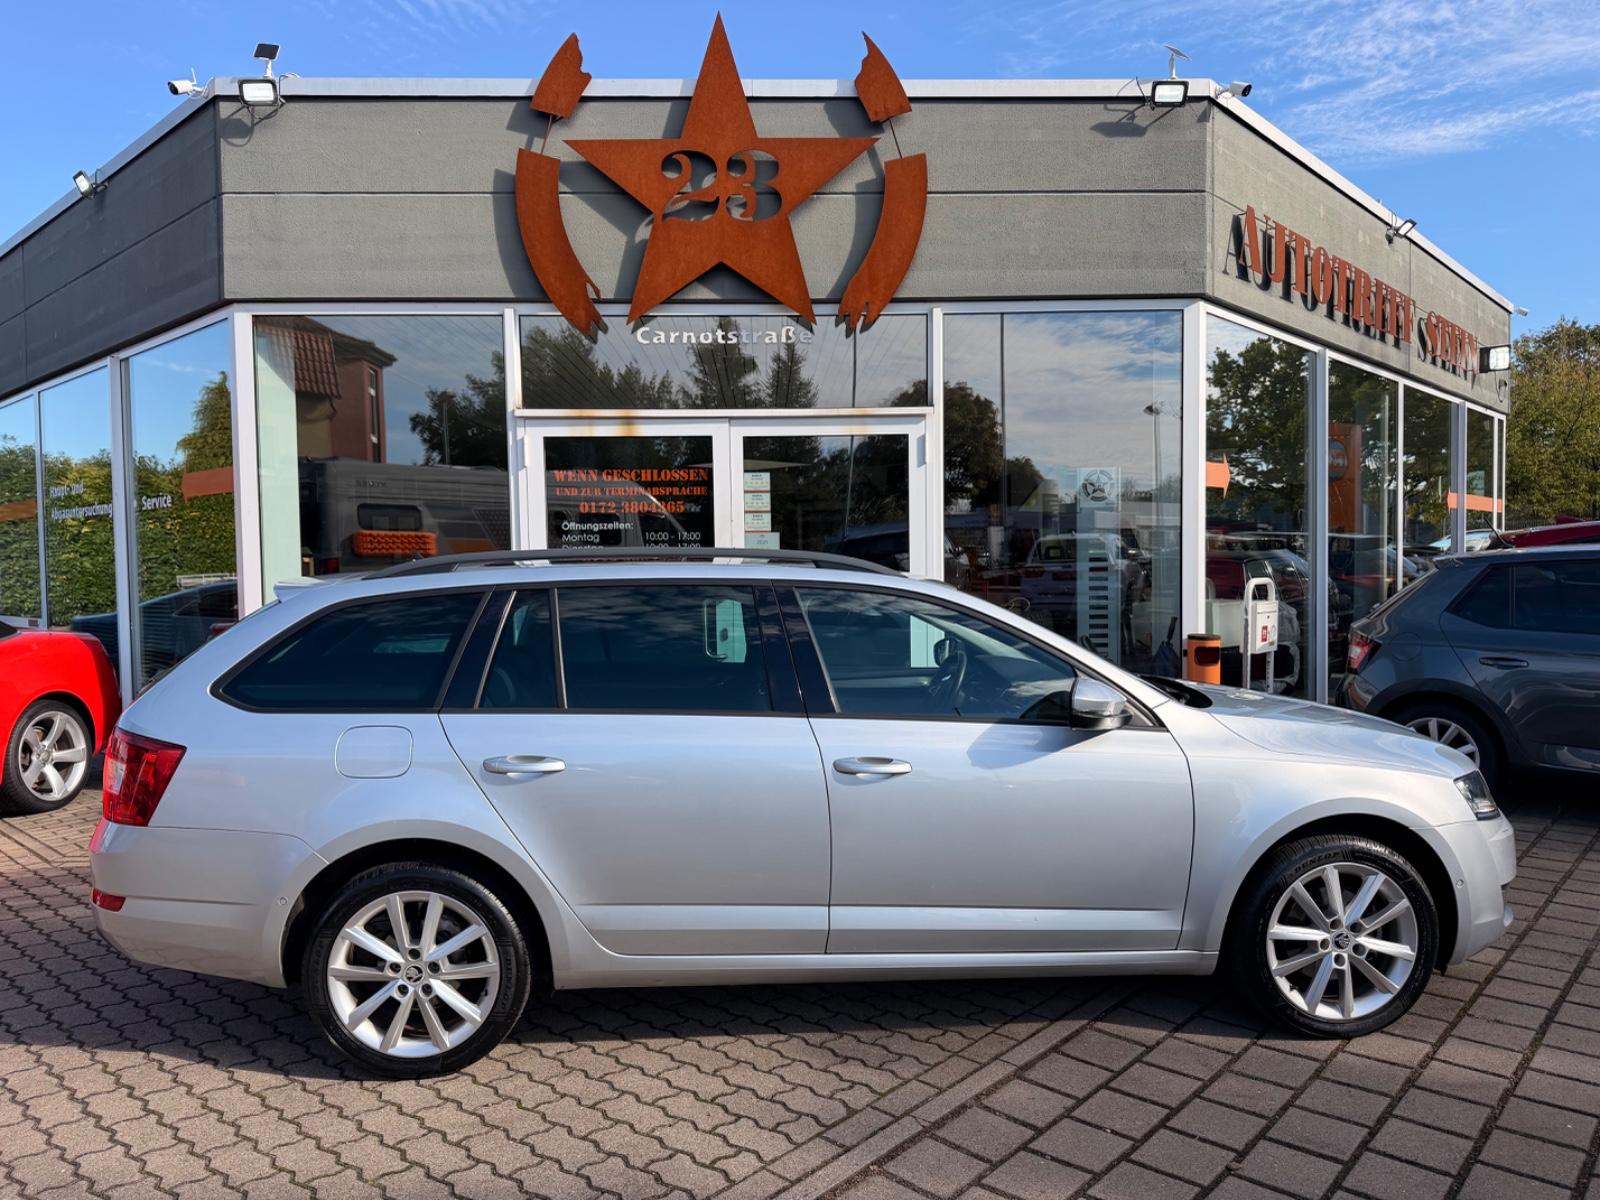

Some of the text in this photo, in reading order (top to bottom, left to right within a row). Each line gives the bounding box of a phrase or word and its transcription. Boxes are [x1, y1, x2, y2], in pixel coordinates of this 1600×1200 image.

[661, 150, 782, 221] 23
[636, 326, 812, 344] Carnotstraße
[554, 468, 708, 482] WENN GESCHLOSSEN
[556, 486, 707, 496] UND ZUR TERMINABSPRACHE
[141, 494, 172, 511] Service
[579, 501, 616, 513] 0172
[561, 520, 634, 531] Öffnungszeiten:
[562, 533, 600, 543] Montag
[645, 532, 669, 541] 10:00
[678, 532, 701, 541] 17:00
